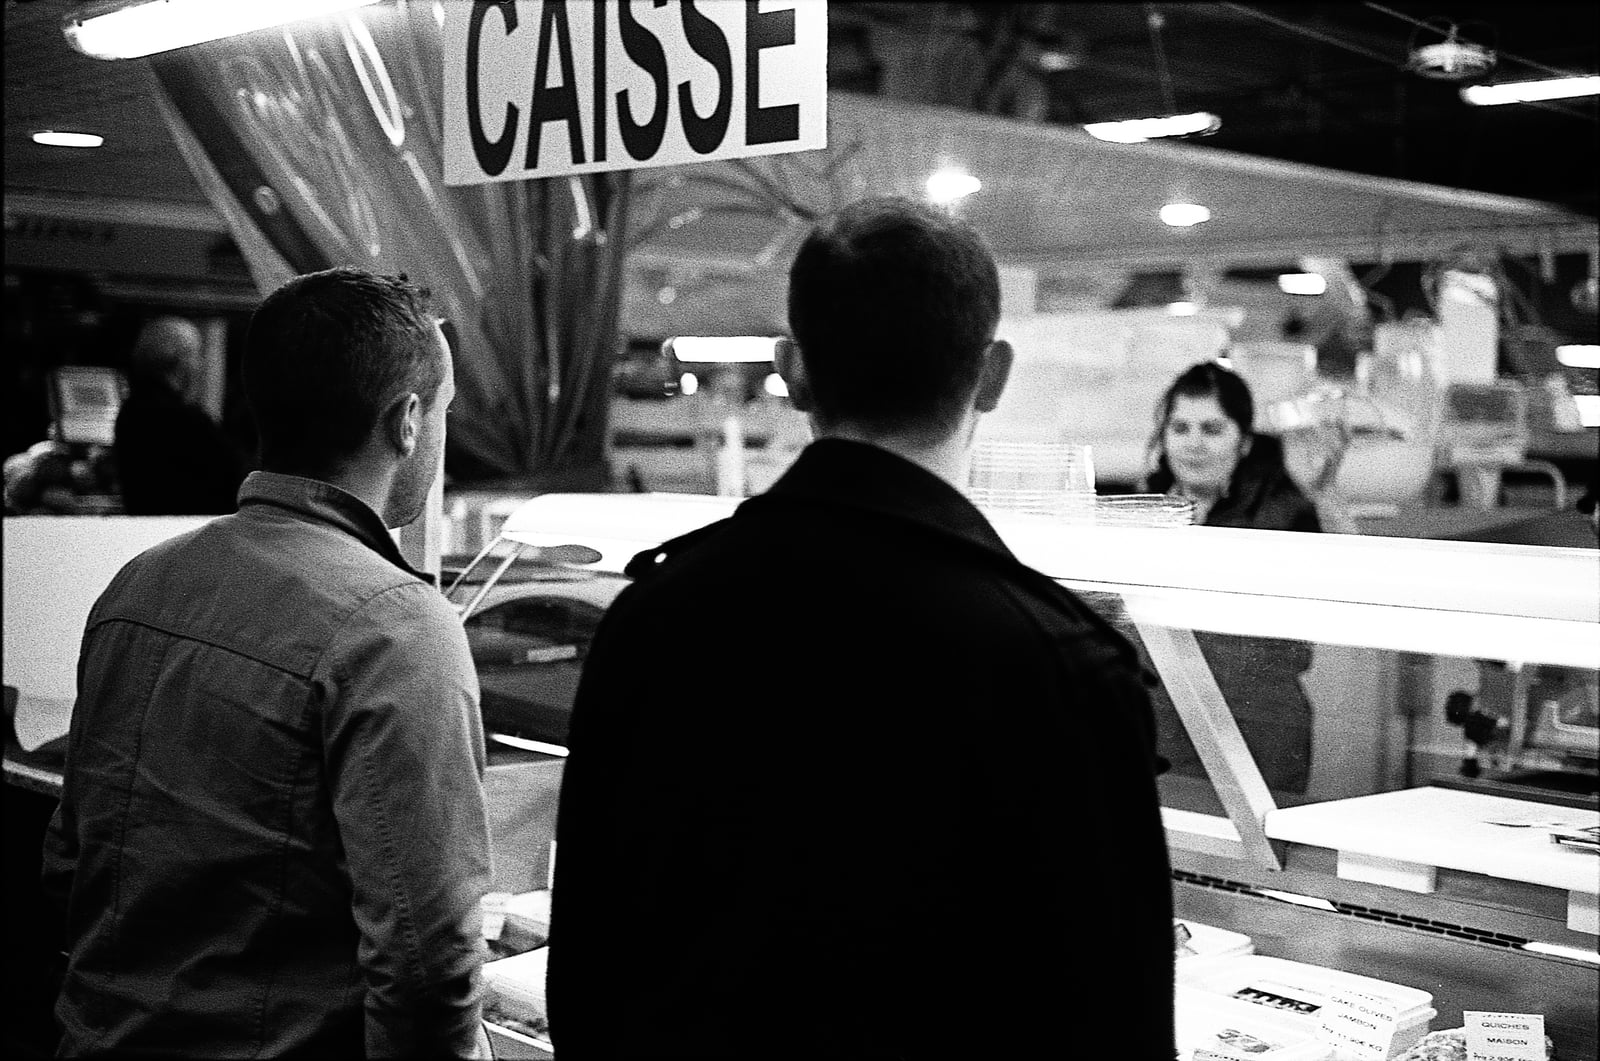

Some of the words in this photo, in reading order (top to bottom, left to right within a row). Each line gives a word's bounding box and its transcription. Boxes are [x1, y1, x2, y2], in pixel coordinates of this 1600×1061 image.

[466, 0, 799, 176] CAISSE
[1358, 1006, 1393, 1021] OLIVES
[1338, 1013, 1377, 1030] JAMBON
[1481, 1022, 1530, 1030] QUICHES
[1487, 1037, 1528, 1045] MAISON
